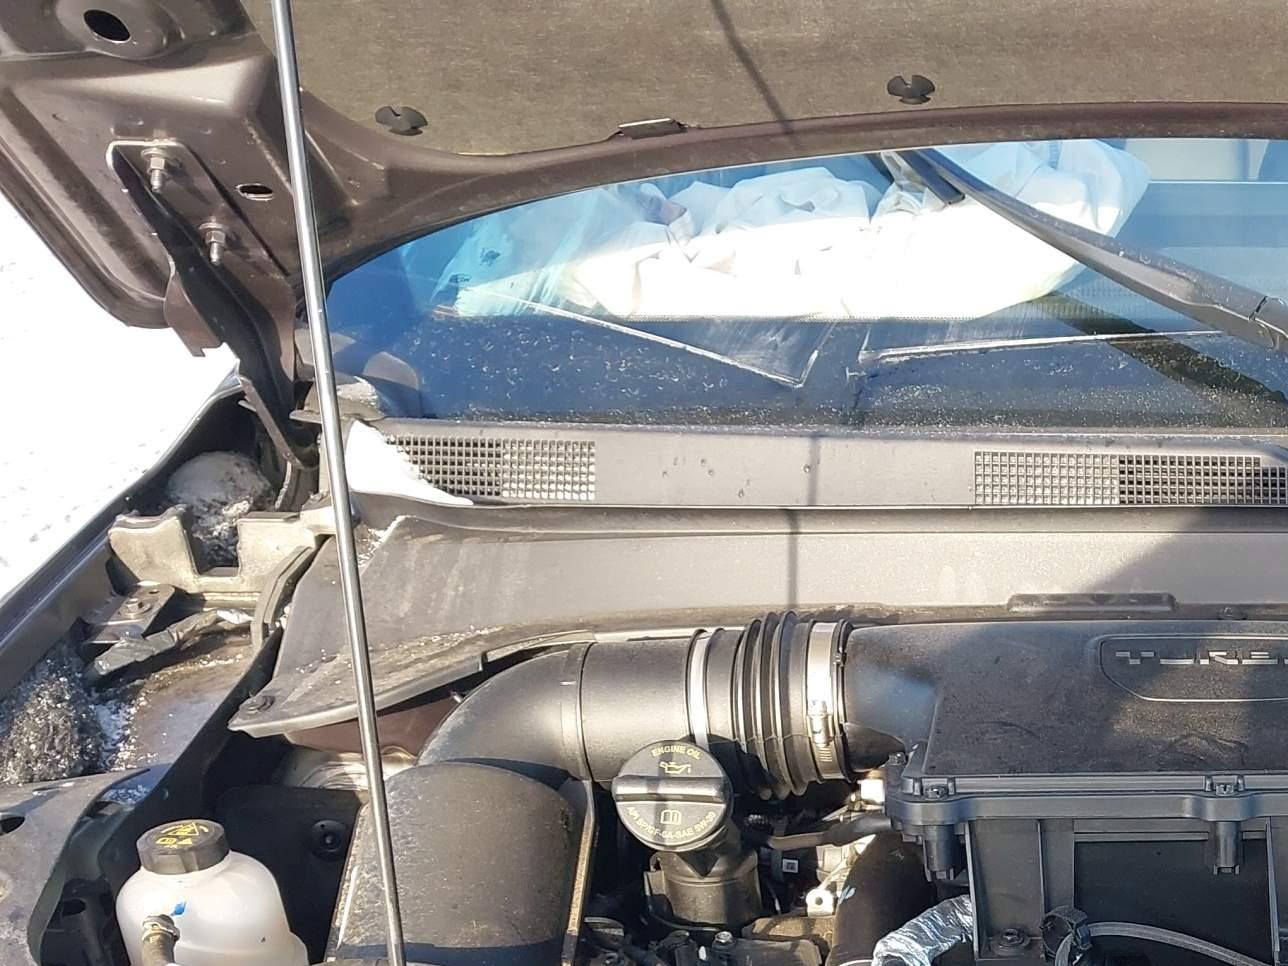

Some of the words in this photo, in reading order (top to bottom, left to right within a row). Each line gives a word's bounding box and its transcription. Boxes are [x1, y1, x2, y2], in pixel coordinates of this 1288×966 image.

[651, 745, 686, 757] ENGINE
[686, 748, 701, 760] OIL
[626, 806, 639, 820] API
[694, 811, 717, 832] 5W-30
